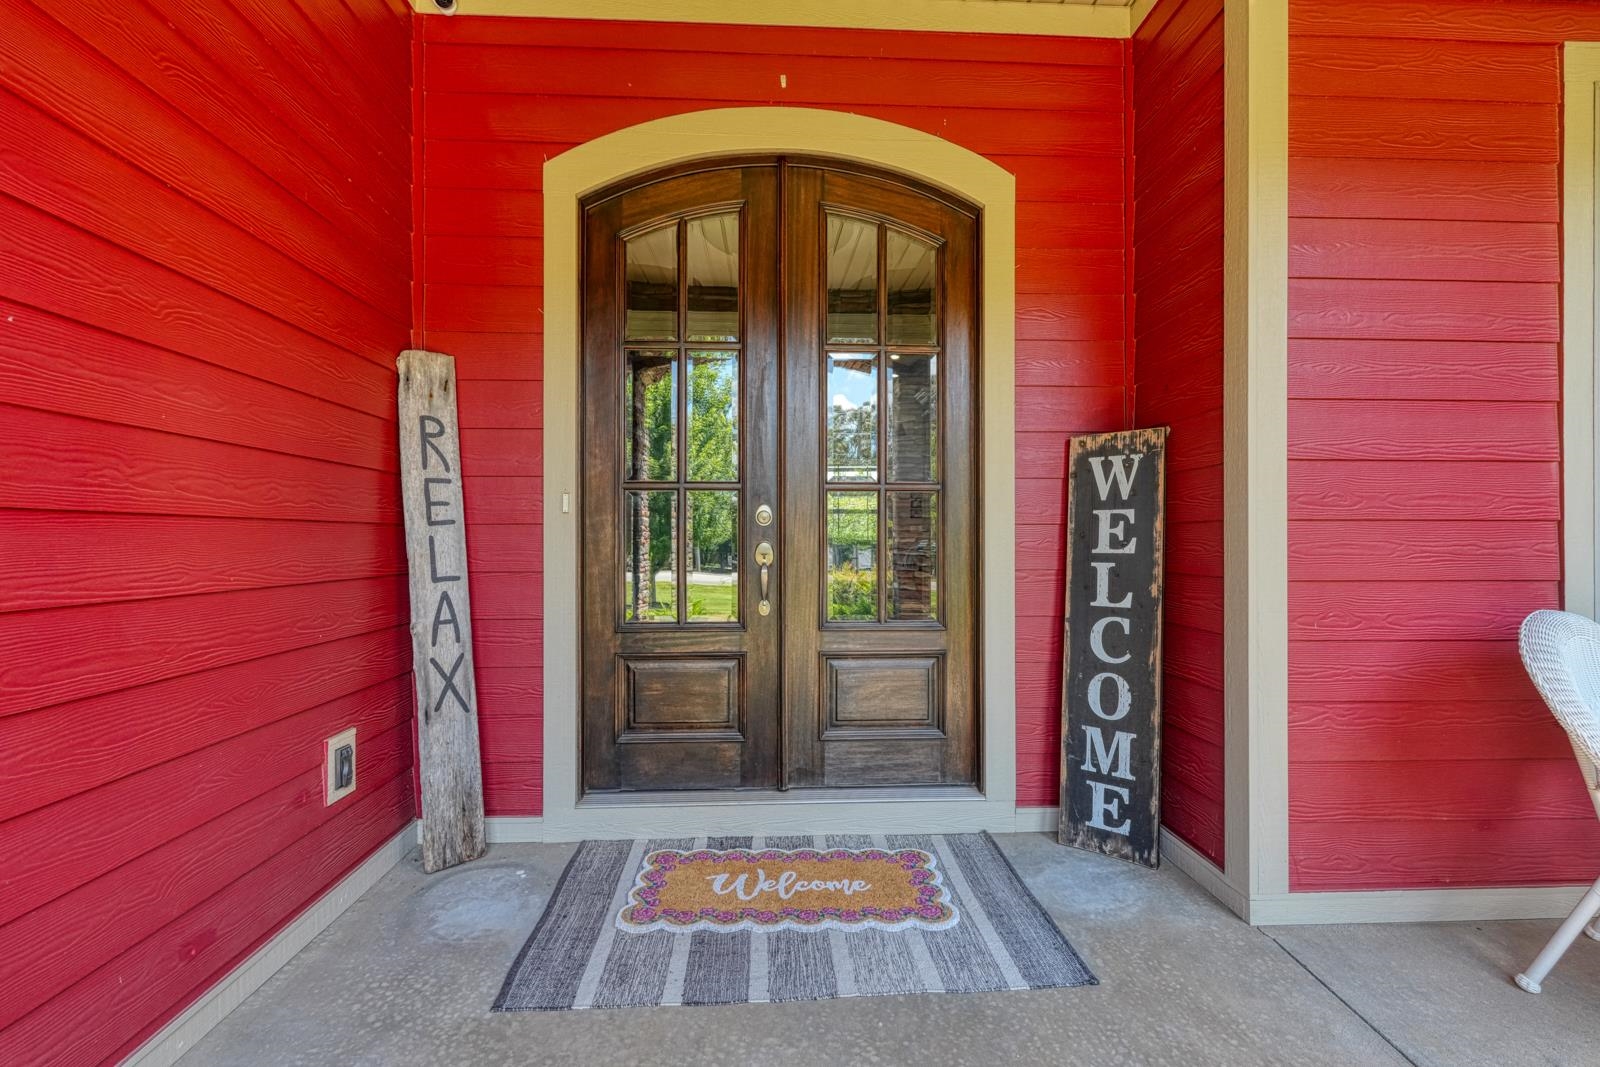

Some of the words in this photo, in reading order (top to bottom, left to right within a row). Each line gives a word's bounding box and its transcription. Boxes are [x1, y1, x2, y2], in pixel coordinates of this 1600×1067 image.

[419, 415, 470, 713] RELAX
[1080, 453, 1143, 837] WELCOME
[706, 868, 872, 900] Welcome
